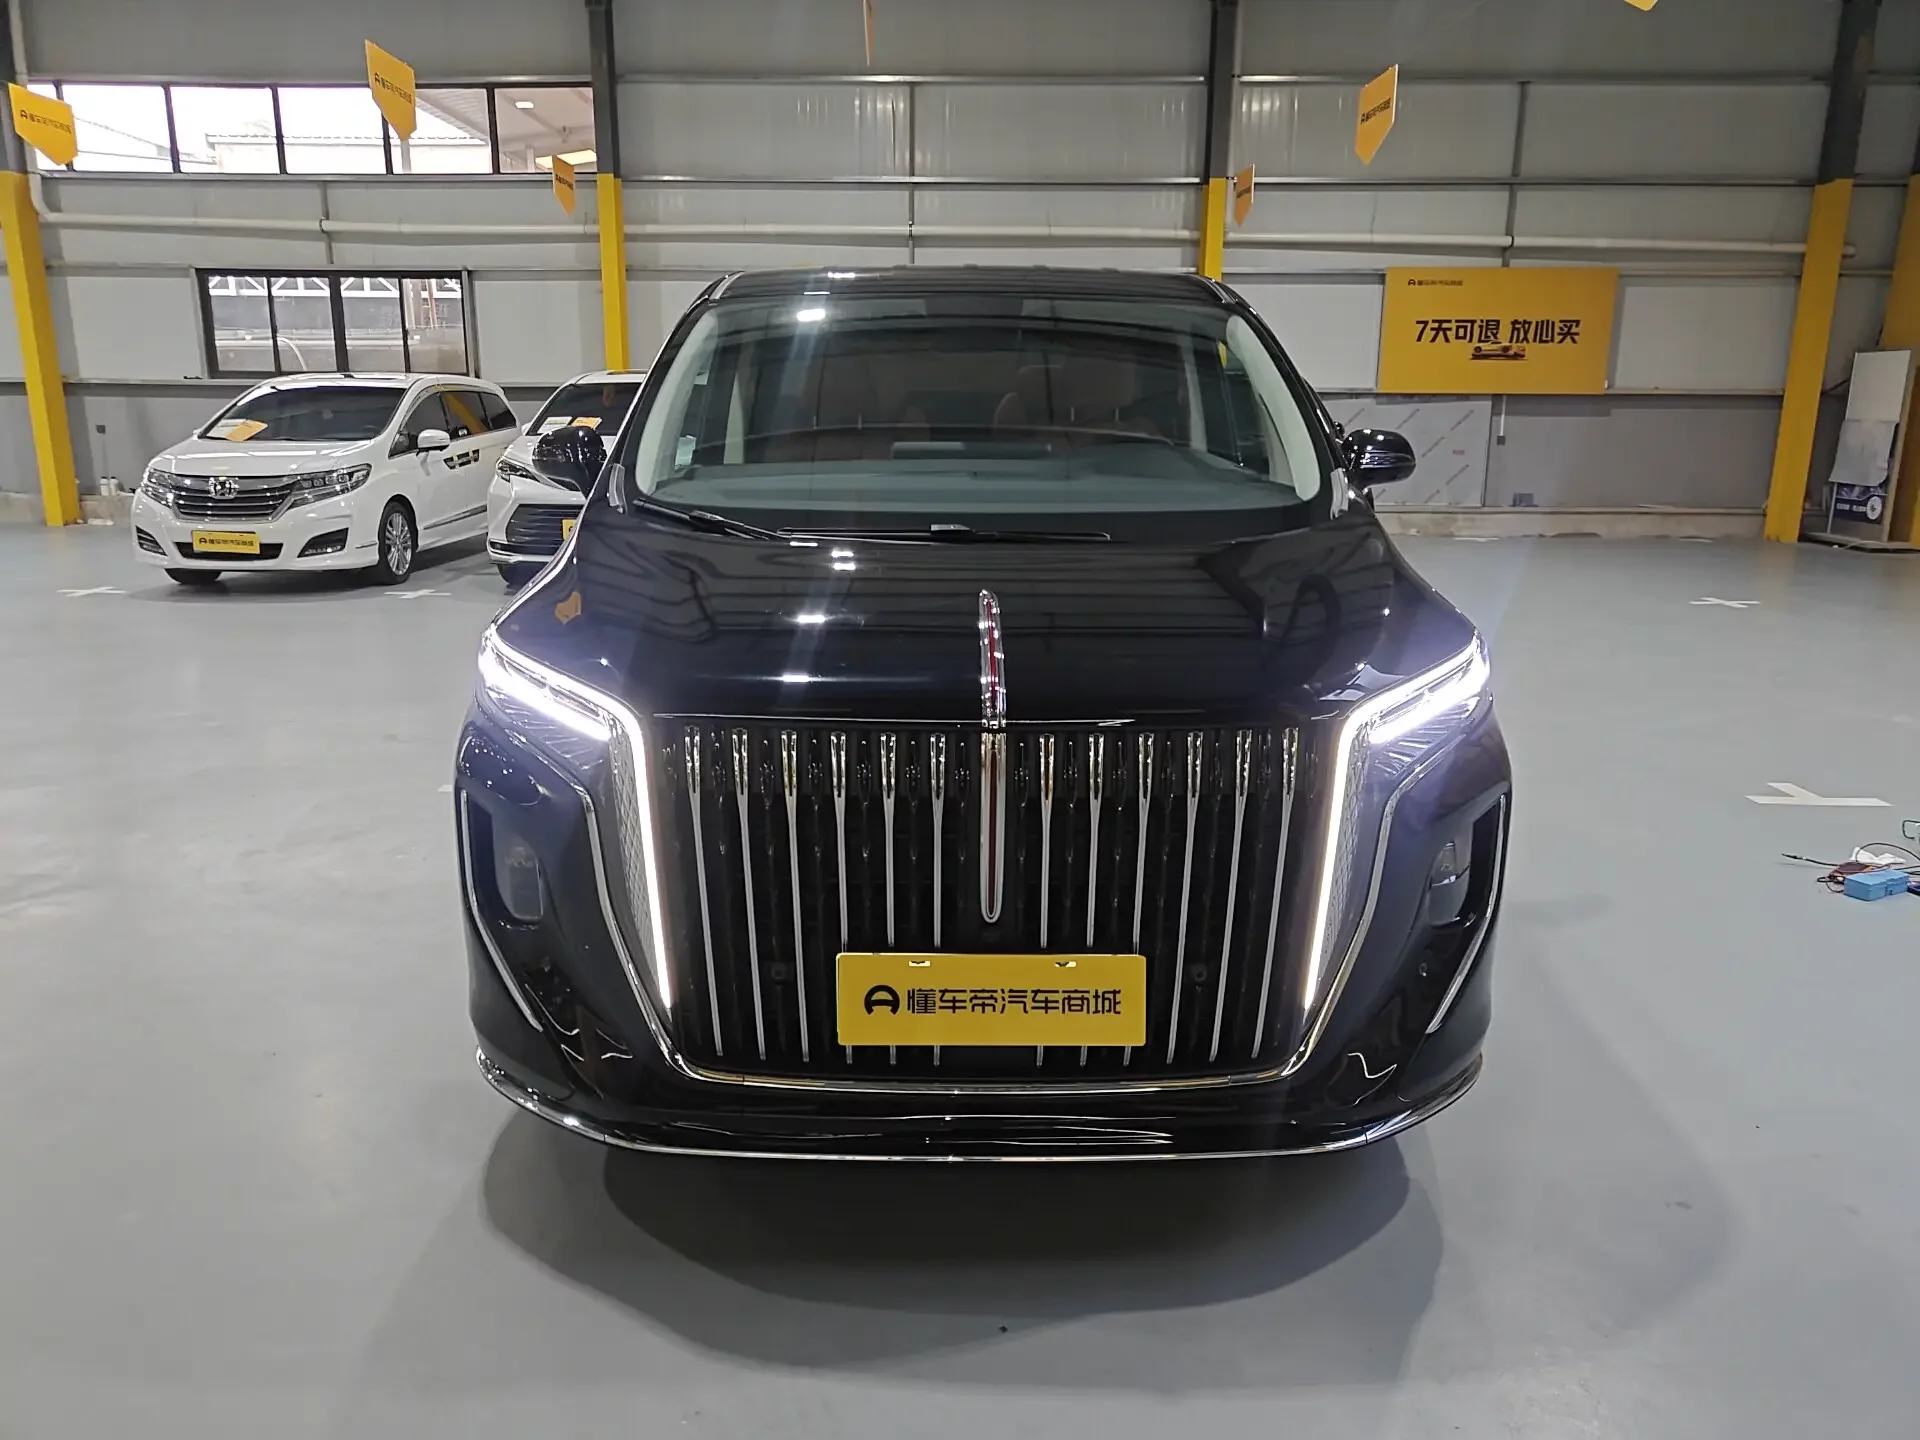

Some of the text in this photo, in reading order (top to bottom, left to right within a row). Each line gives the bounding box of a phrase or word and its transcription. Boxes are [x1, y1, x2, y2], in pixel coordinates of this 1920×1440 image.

[1415, 319, 1581, 344] 7天可退 放心买
[907, 988, 1122, 1014] 懂车帝汽车商城
